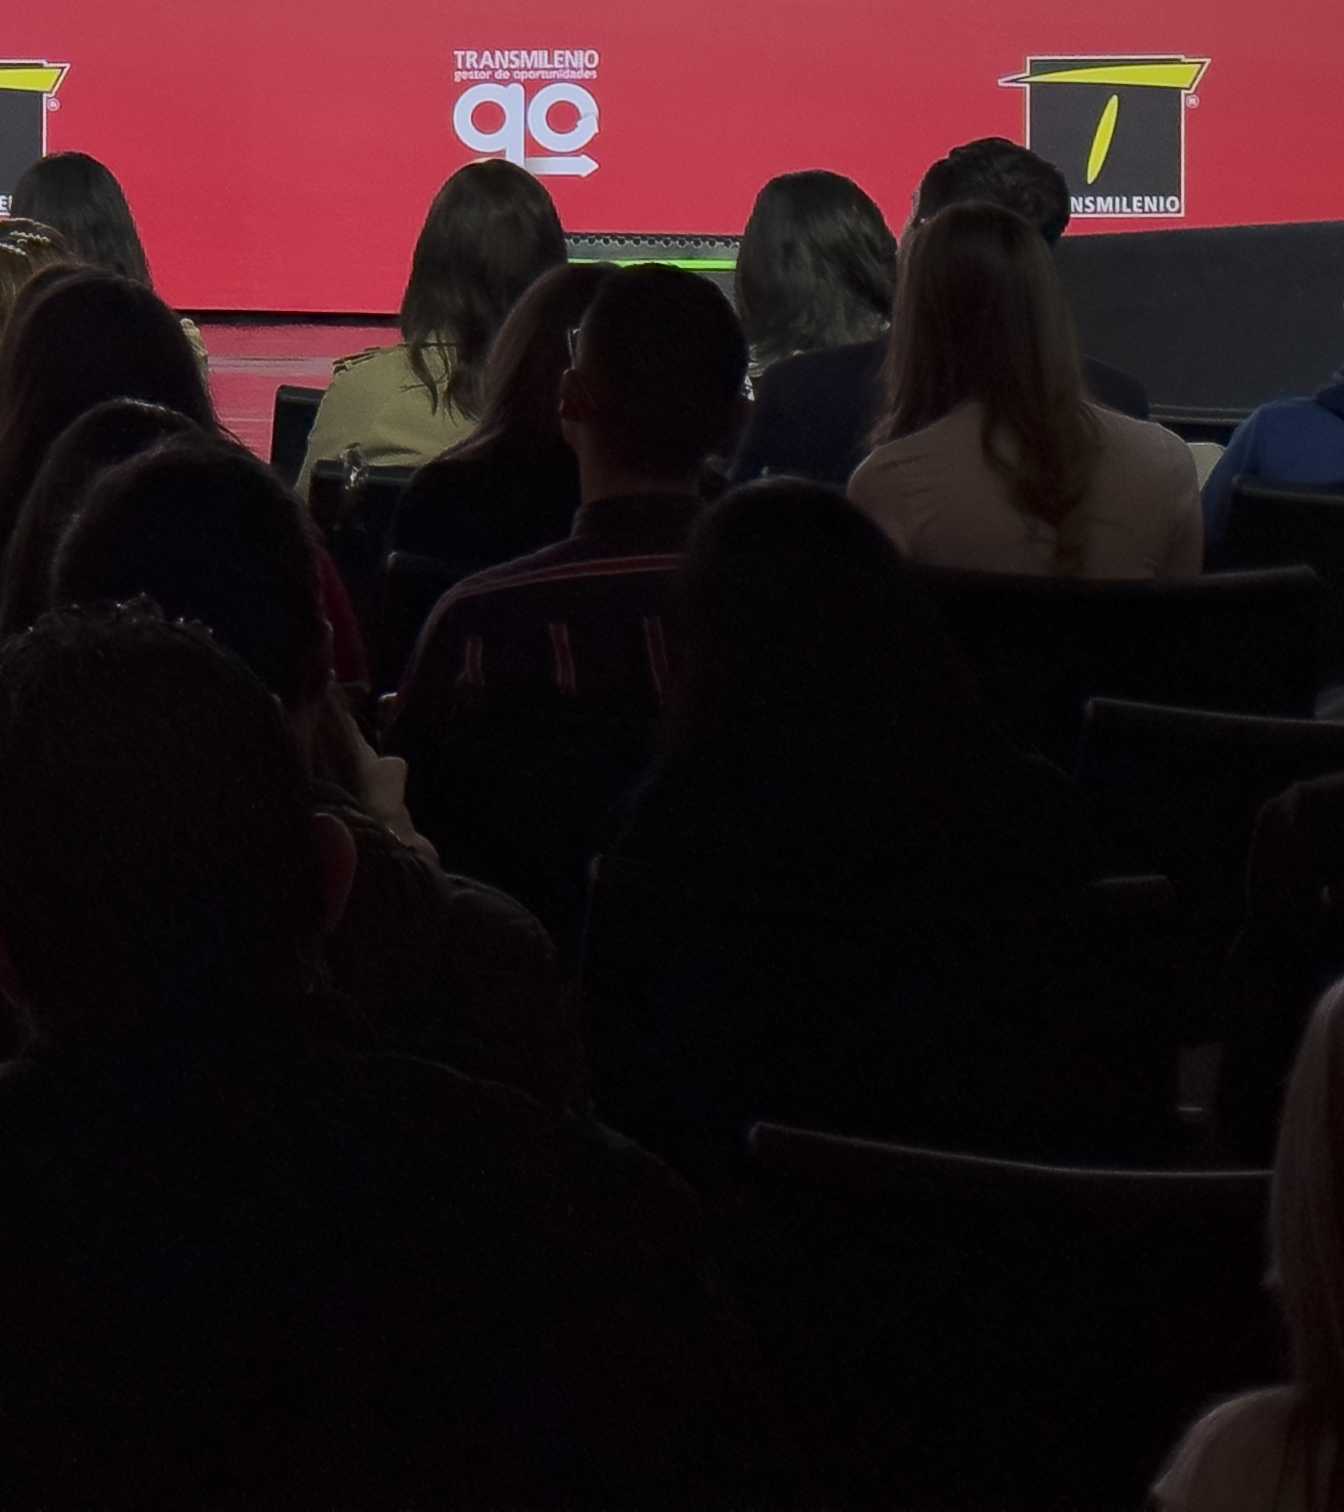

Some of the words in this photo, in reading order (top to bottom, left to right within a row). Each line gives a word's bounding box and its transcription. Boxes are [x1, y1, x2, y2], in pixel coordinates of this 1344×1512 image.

[453, 50, 599, 69] TRANSMILENIO
[454, 70, 492, 82] gestor
[495, 69, 510, 79] de
